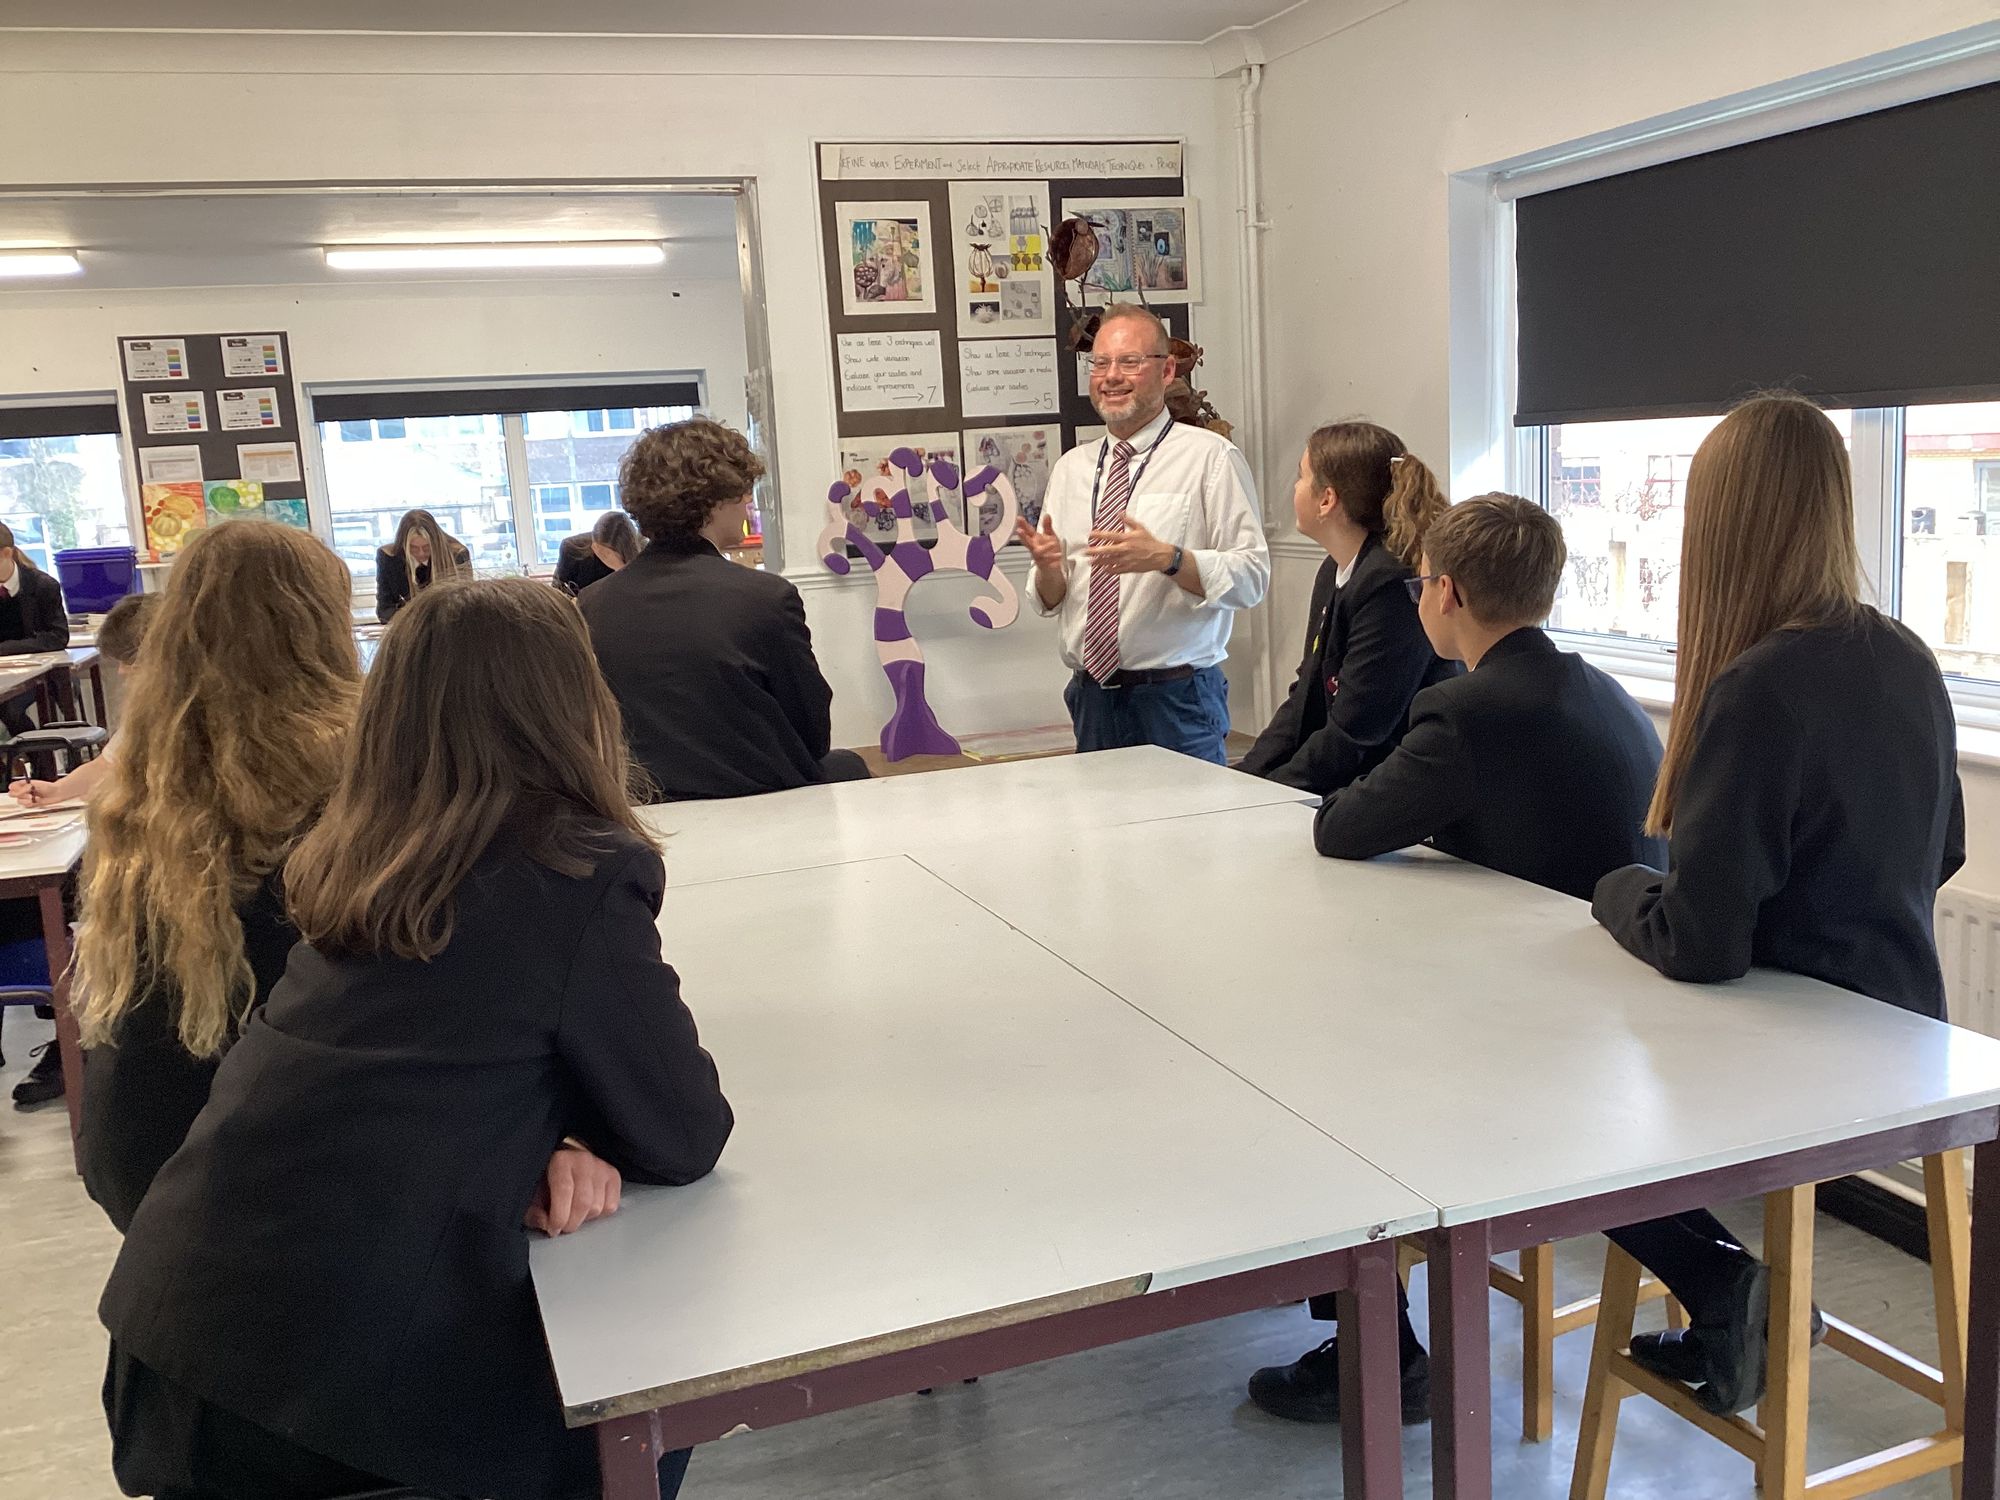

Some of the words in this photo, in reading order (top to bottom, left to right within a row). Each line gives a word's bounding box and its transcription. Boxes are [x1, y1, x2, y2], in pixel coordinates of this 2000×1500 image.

[840, 156, 866, 170] EFINE
[956, 158, 981, 172] Select
[868, 336, 882, 346] least
[886, 335, 893, 346] 3
[894, 339, 923, 349] techniques
[924, 338, 935, 346] well
[964, 347, 981, 359] Show
[1014, 344, 1022, 358] 3
[1024, 349, 1051, 359] techniques
[844, 354, 861, 364] Show
[874, 371, 886, 382] your
[965, 366, 982, 376] Show
[927, 385, 937, 403] 7
[993, 384, 1006, 396] your
[1043, 392, 1053, 410] 5
